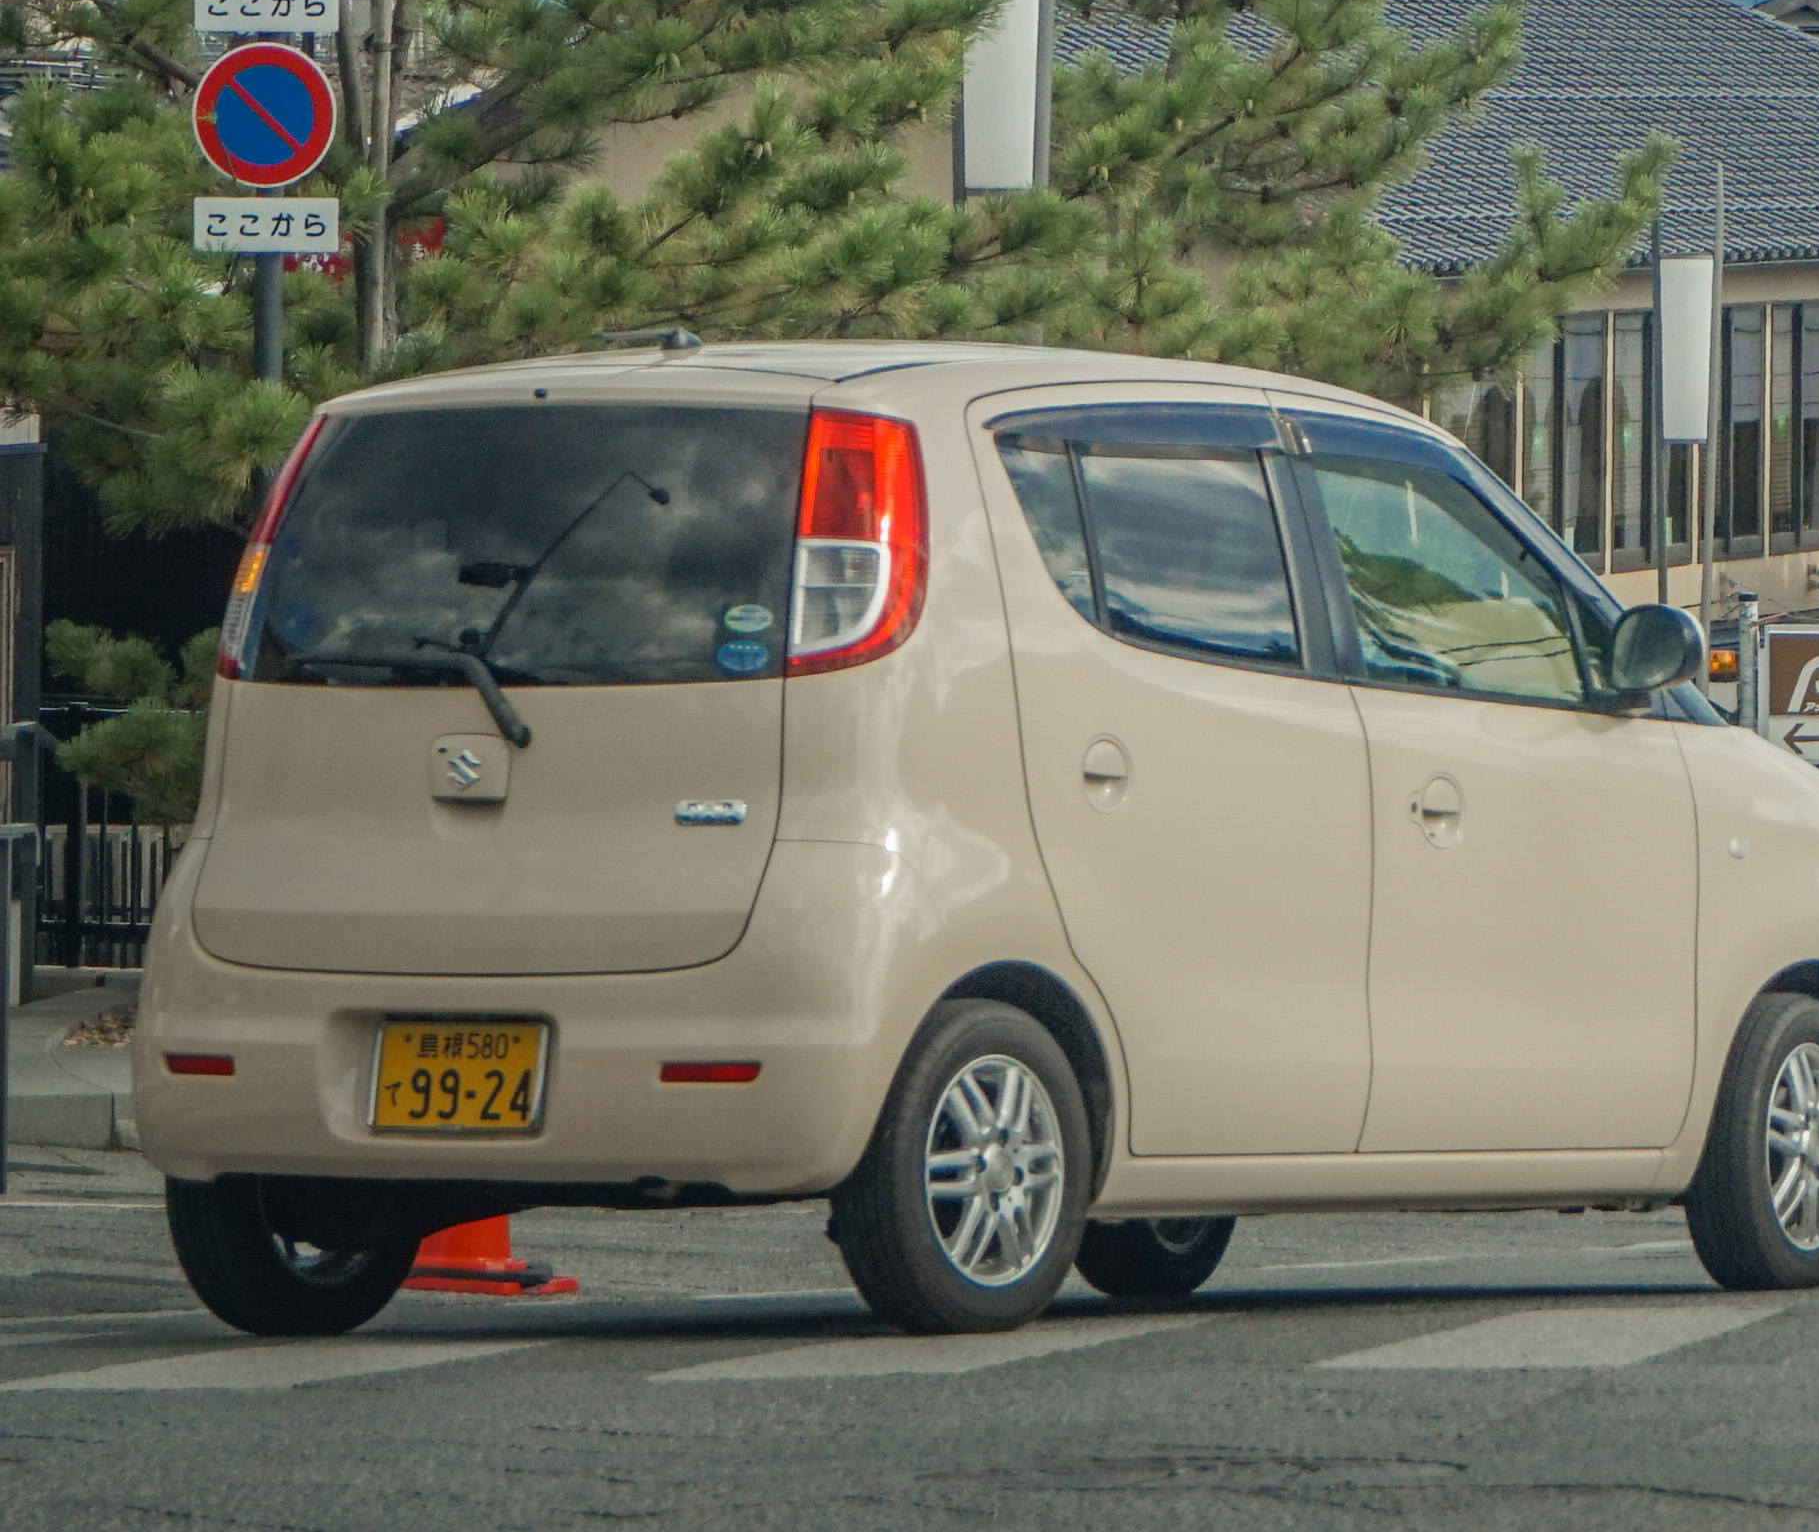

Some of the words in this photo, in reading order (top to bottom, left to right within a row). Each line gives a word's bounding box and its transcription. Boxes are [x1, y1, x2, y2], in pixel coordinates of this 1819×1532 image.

[206, 213, 326, 237] ここから
[417, 1033, 509, 1059] 島根580
[384, 1082, 402, 1106] て
[408, 1068, 532, 1121] 99-24
